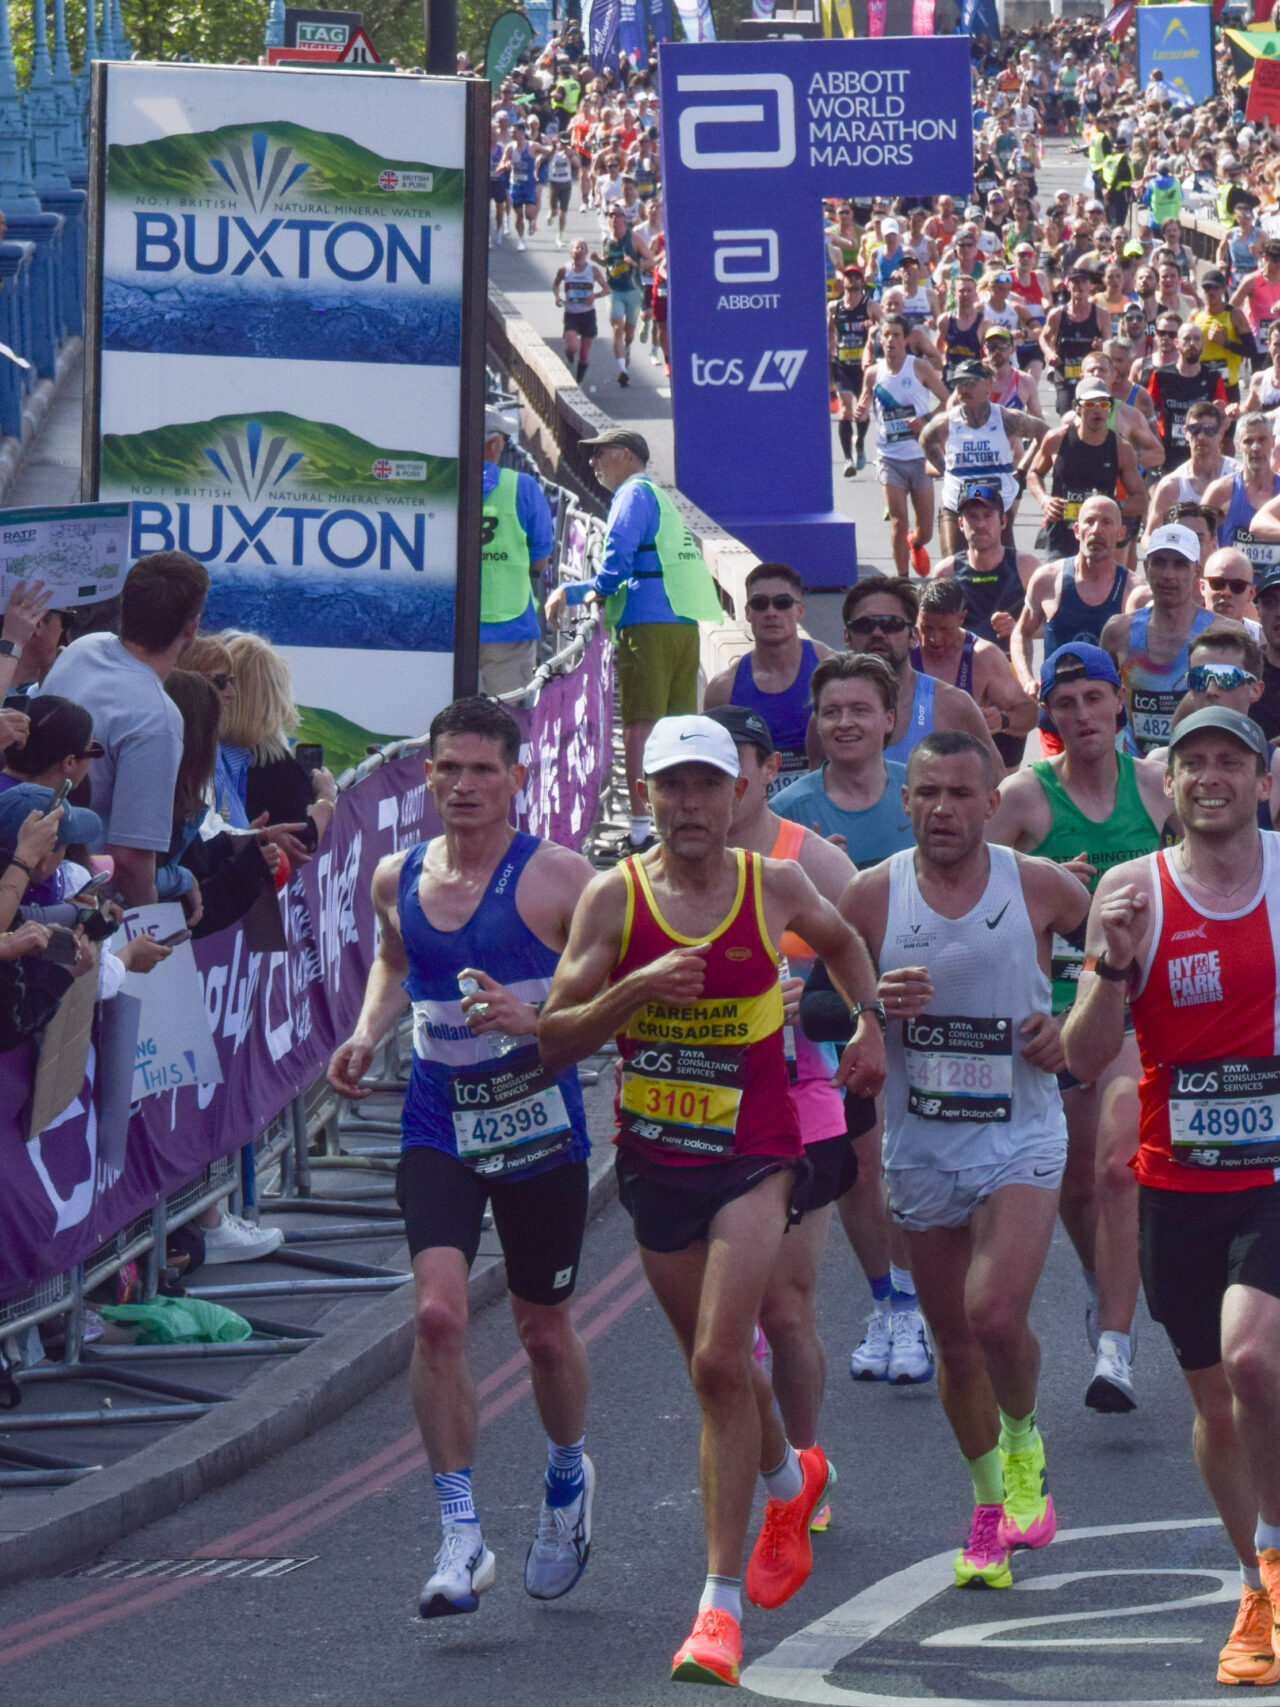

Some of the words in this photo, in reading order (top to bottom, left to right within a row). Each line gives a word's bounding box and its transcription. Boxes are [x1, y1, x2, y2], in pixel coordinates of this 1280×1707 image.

[302, 26, 344, 41] TAG
[494, 28, 526, 73] NSPCC
[808, 70, 910, 94] ABBOTT
[807, 97, 905, 118] WORLD
[809, 119, 957, 143] MARATHON
[810, 144, 914, 167] MAJORS
[179, 199, 238, 209] BRITISH
[274, 203, 329, 215] NATURAL
[334, 205, 387, 217] MINERAL
[391, 208, 432, 219] WATER
[133, 211, 432, 285] BUXTON
[717, 294, 781, 310] ABBOTT
[691, 352, 745, 386] tcs
[963, 440, 990, 451] GLUE
[956, 451, 1000, 464] FACTORY
[174, 488, 232, 498] BRITISH
[269, 492, 323, 502] NATURAL
[328, 494, 380, 504] MINERAL
[385, 496, 426, 506] WATER
[4, 530, 37, 541] RATP
[131, 500, 426, 572] BUXTON
[480, 552, 508, 562] ance
[1134, 693, 1157, 711] tcs
[1143, 719, 1170, 736] 482
[495, 863, 514, 894] soar
[1168, 950, 1221, 980] HYDE
[1170, 971, 1222, 1002] PARK
[1173, 990, 1223, 1008] HARRIERS
[647, 1004, 738, 1021] FAREHAM
[638, 1022, 749, 1039] CRUSADERS
[907, 1021, 944, 1046] tcs
[949, 1022, 973, 1031] TATA
[948, 1031, 1005, 1041] CONSULTANCY
[948, 1039, 984, 1049] SERVICES
[679, 1050, 705, 1059] TATA
[676, 1066, 715, 1078] SERVICES
[677, 1059, 740, 1073] CONSULTANCY
[1223, 1064, 1249, 1073] TATA
[491, 1072, 514, 1085] TATA
[492, 1066, 545, 1094] CONSULTANCY
[917, 1060, 993, 1090] 41288
[1178, 1068, 1218, 1093] tcs
[454, 1078, 490, 1104] tcs
[494, 1083, 529, 1102] SERVICES
[1223, 1081, 1264, 1092] SERVICES
[645, 1087, 711, 1121] 3101
[941, 1108, 960, 1118] new
[1189, 1105, 1274, 1136] 48903
[472, 1101, 549, 1144] 42398
[661, 1134, 683, 1145] new
[683, 1137, 724, 1153] balance
[506, 1156, 527, 1169] new
[527, 1142, 564, 1163] balance
[1220, 1156, 1242, 1166] new
